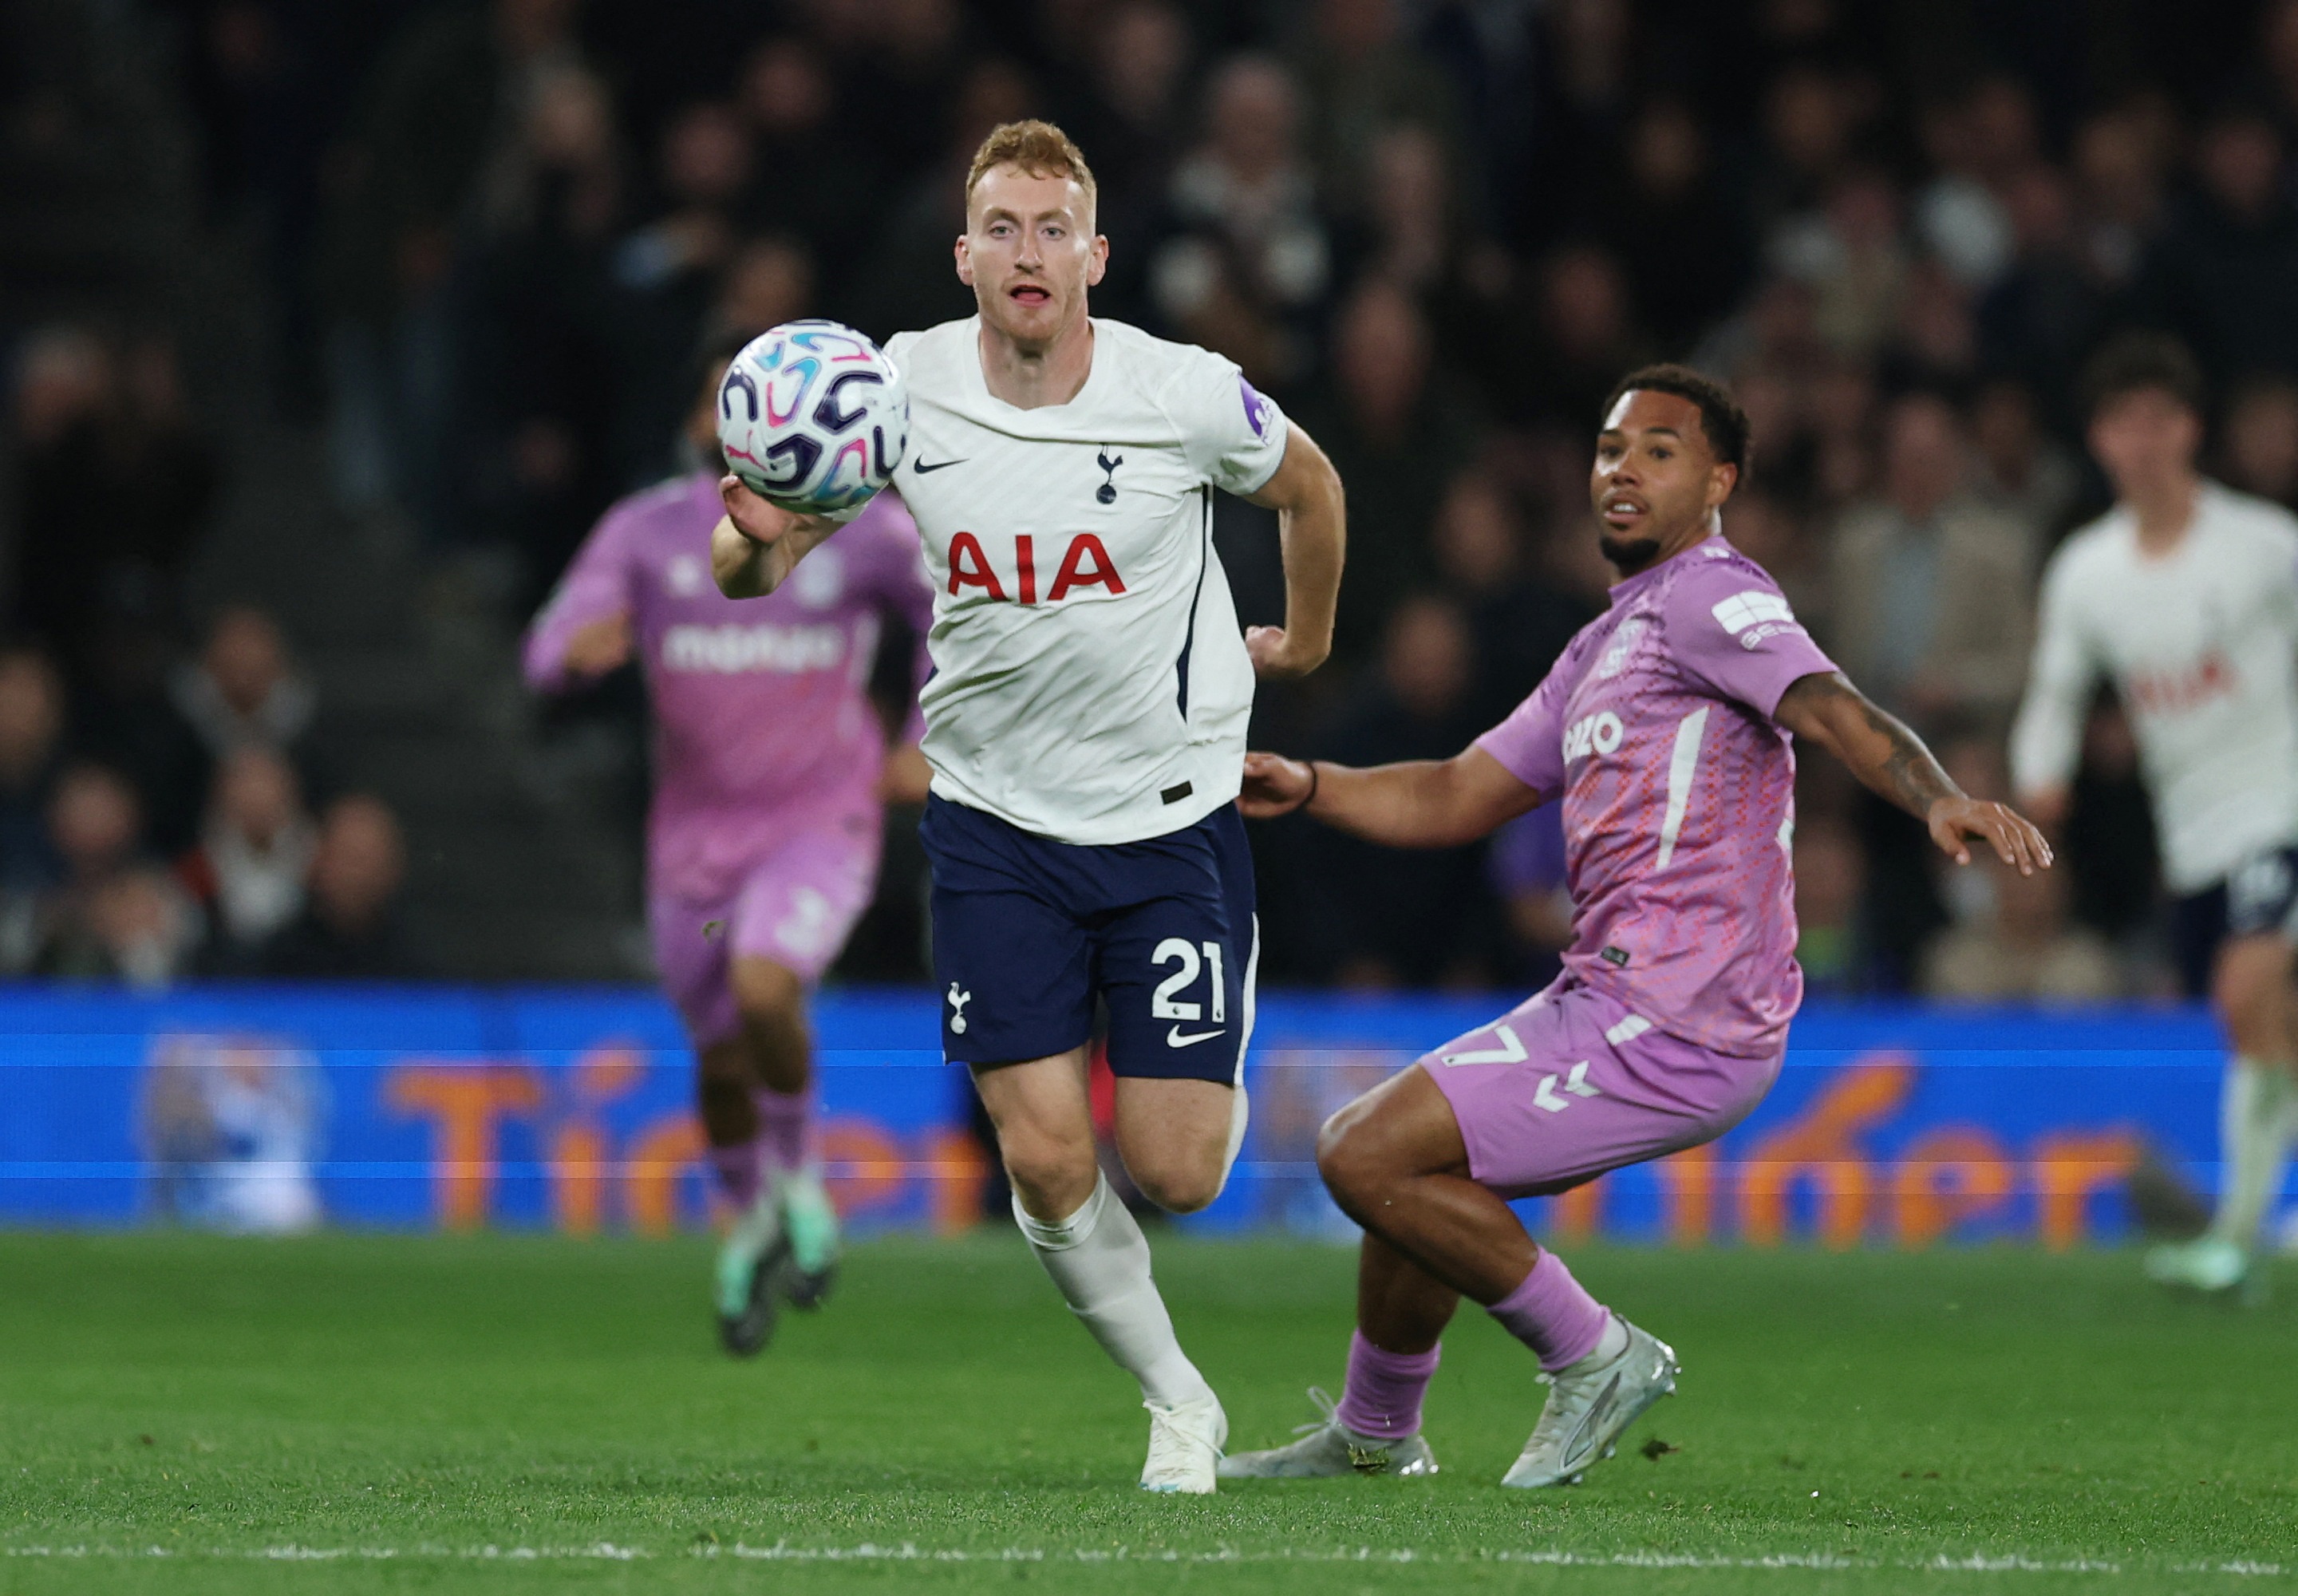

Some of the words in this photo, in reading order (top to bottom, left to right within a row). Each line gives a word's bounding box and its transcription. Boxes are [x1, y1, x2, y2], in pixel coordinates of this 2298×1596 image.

[948, 531, 1127, 605] AIA
[1151, 937, 1226, 1023] 21
[1434, 1021, 1529, 1068] 7
